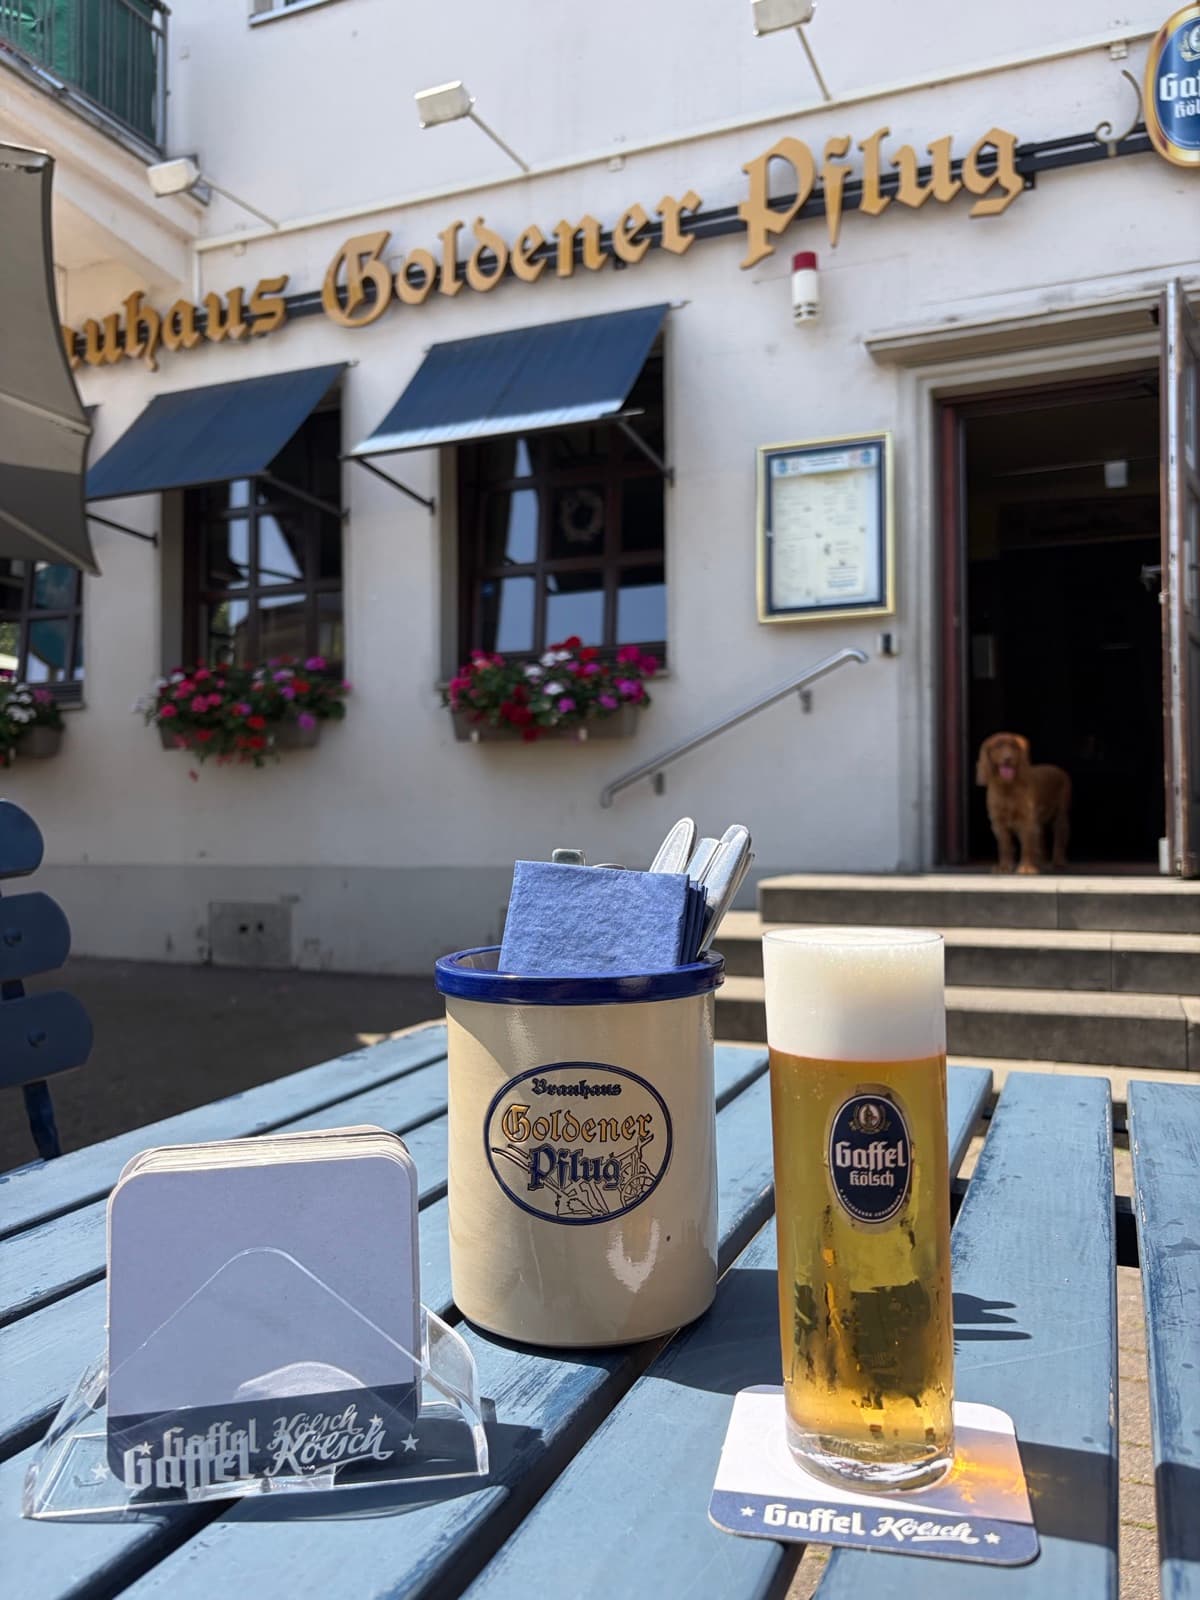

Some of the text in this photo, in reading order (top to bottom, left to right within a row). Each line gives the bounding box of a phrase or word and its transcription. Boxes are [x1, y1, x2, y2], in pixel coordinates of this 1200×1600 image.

[321, 189, 702, 328] Goldener
[738, 126, 1026, 270] Pflug
[531, 1077, 622, 1100] Brauhaus
[501, 1103, 653, 1143] Goldener
[527, 1143, 624, 1191] Pflug
[835, 1139, 907, 1171] Gaffel
[850, 1170, 895, 1187] Kölsch
[123, 1420, 394, 1498] Gaffel Kölsch
[763, 1503, 980, 1545] Gaffel Kölsch
